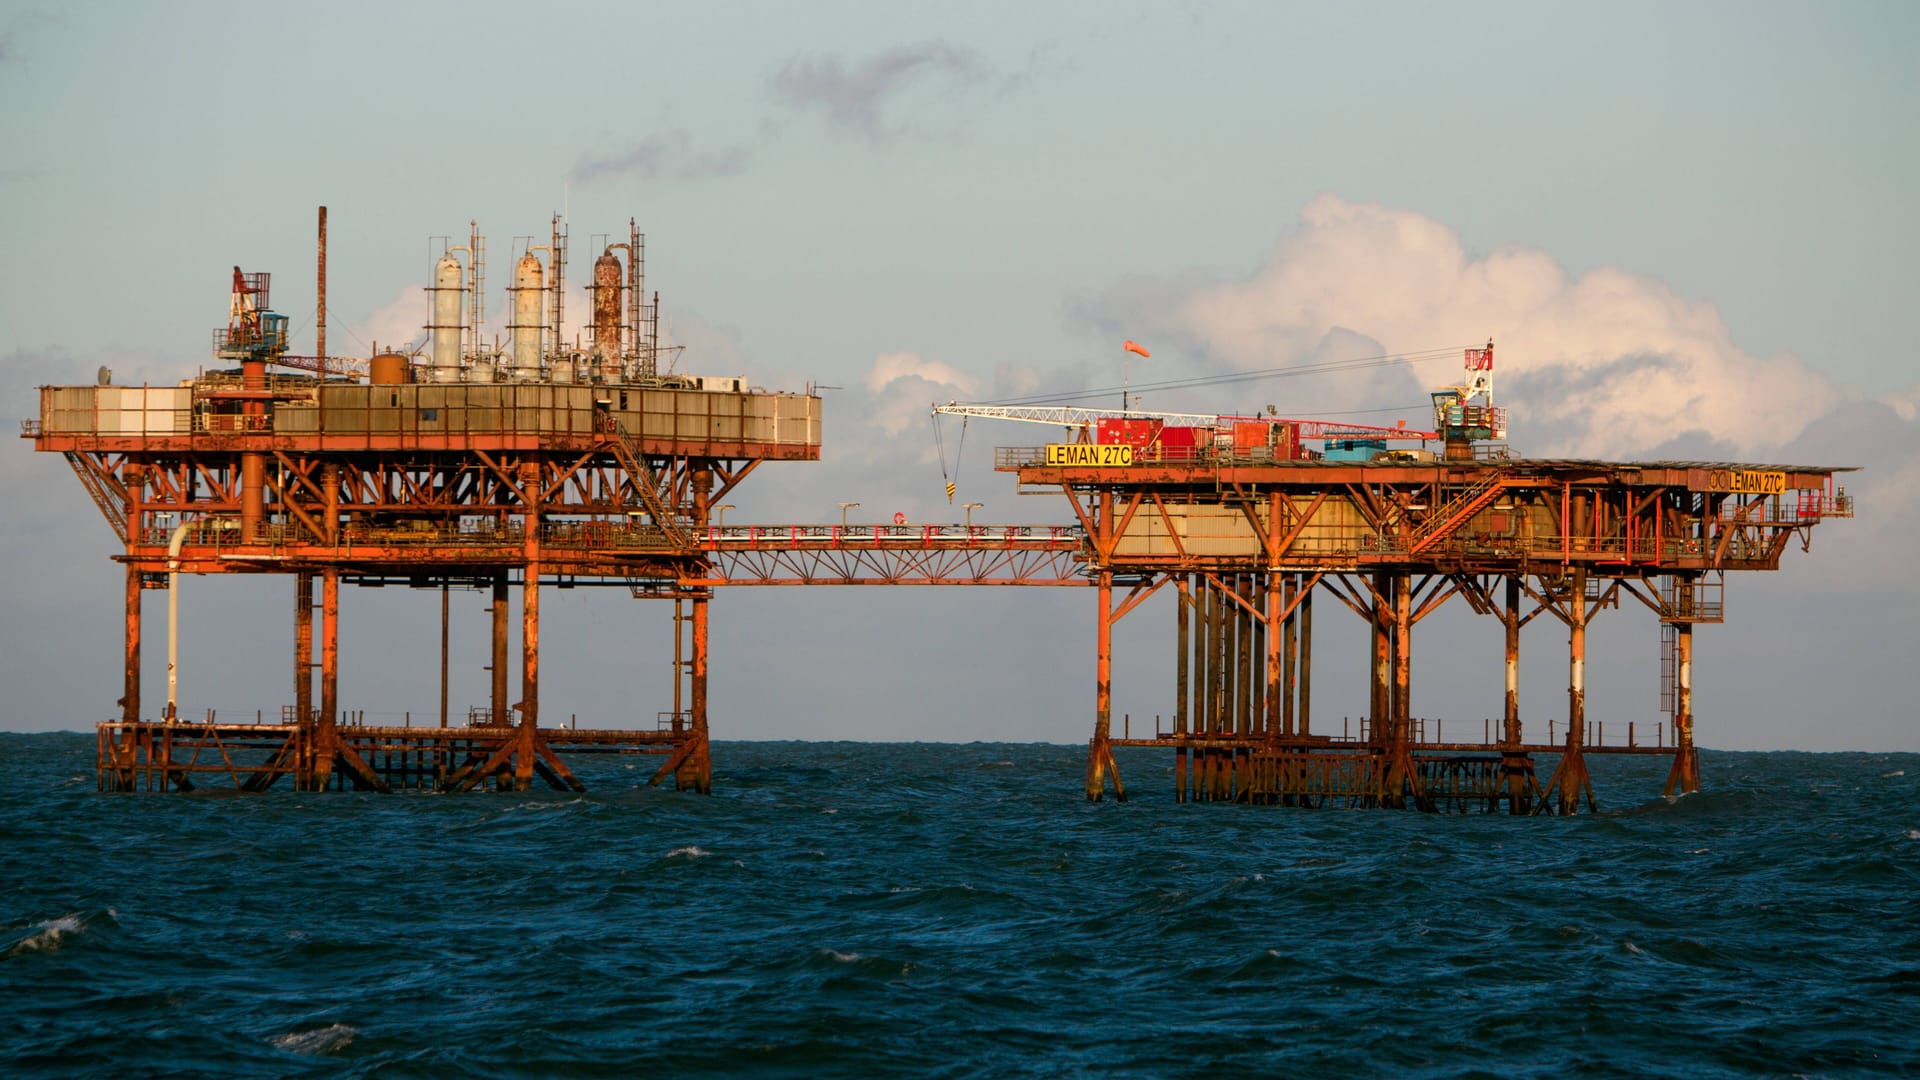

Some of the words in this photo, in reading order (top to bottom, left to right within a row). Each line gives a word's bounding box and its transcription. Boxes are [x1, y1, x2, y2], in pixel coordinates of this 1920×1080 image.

[1047, 446, 1099, 464] LEMAN
[1104, 446, 1130, 464] 27C
[1729, 472, 1761, 491] LEMAN
[1763, 474, 1781, 492] 27C
